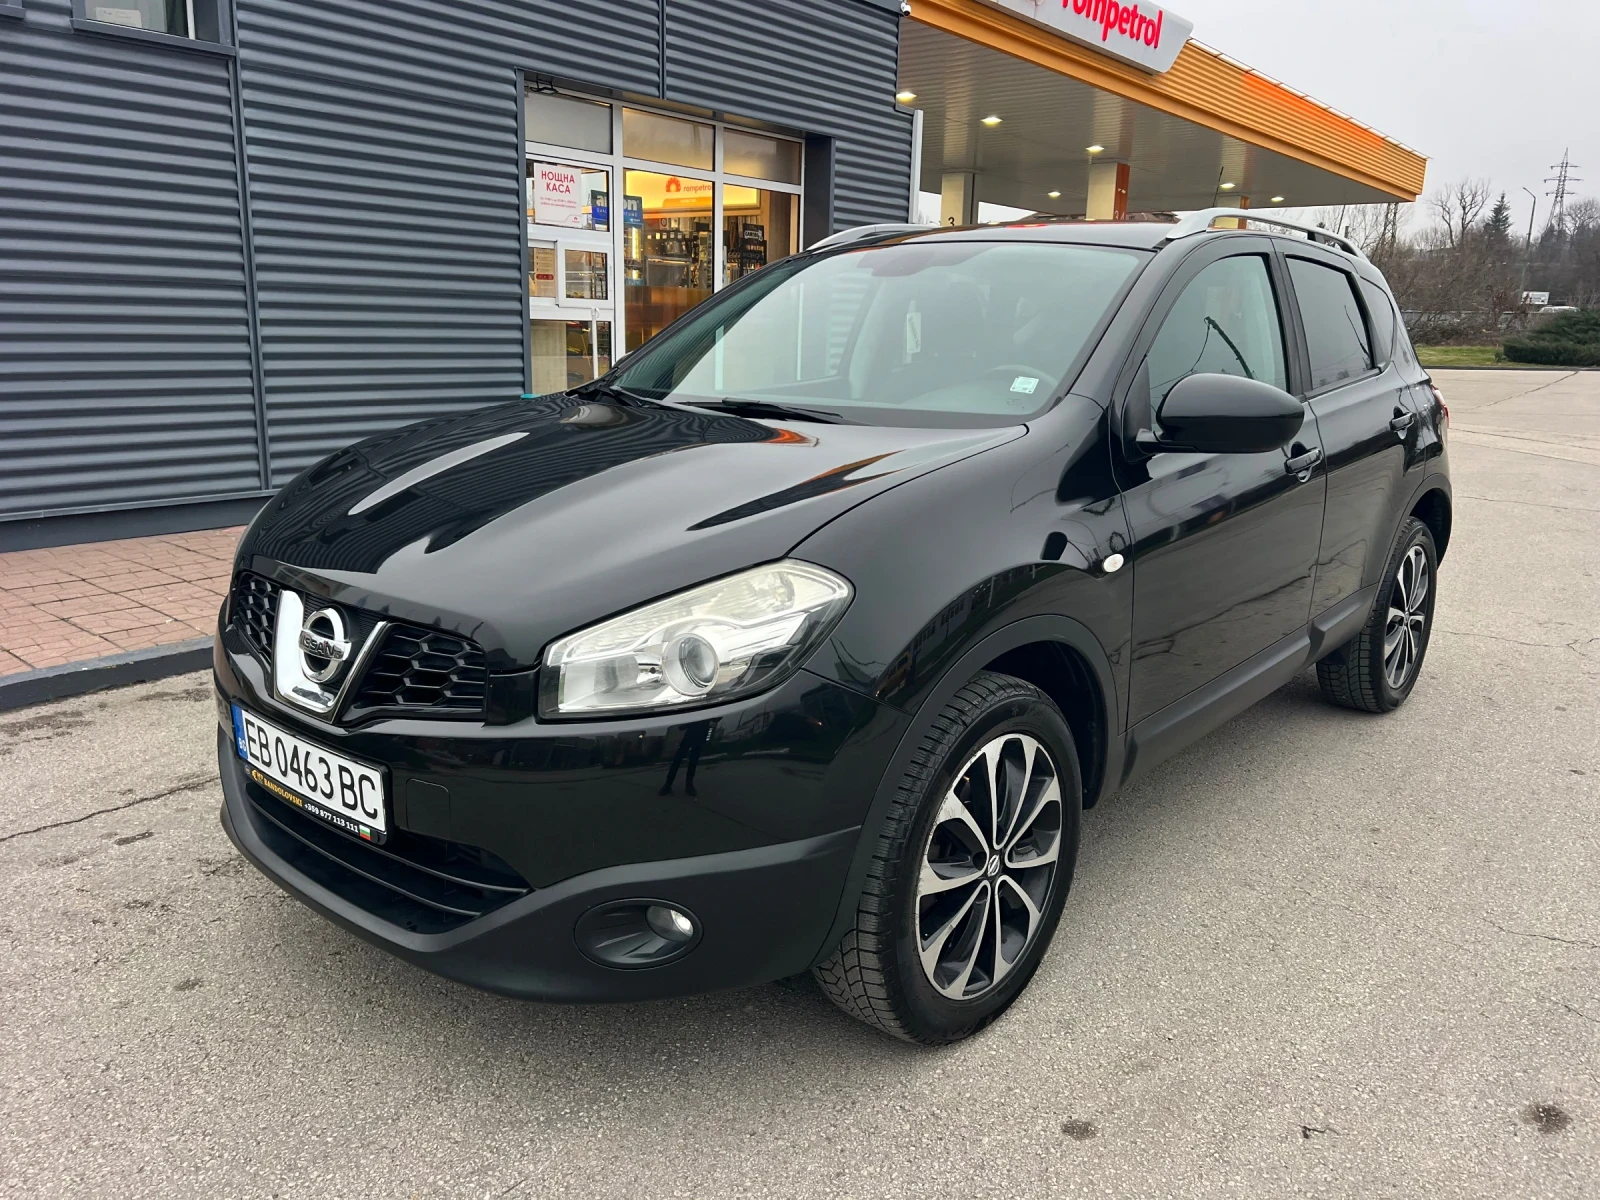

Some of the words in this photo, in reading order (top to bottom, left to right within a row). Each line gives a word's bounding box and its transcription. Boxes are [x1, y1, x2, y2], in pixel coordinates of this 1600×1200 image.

[541, 170, 575, 184] НОЩНА
[546, 182, 571, 194] КАСА
[683, 183, 712, 194] rompetro
